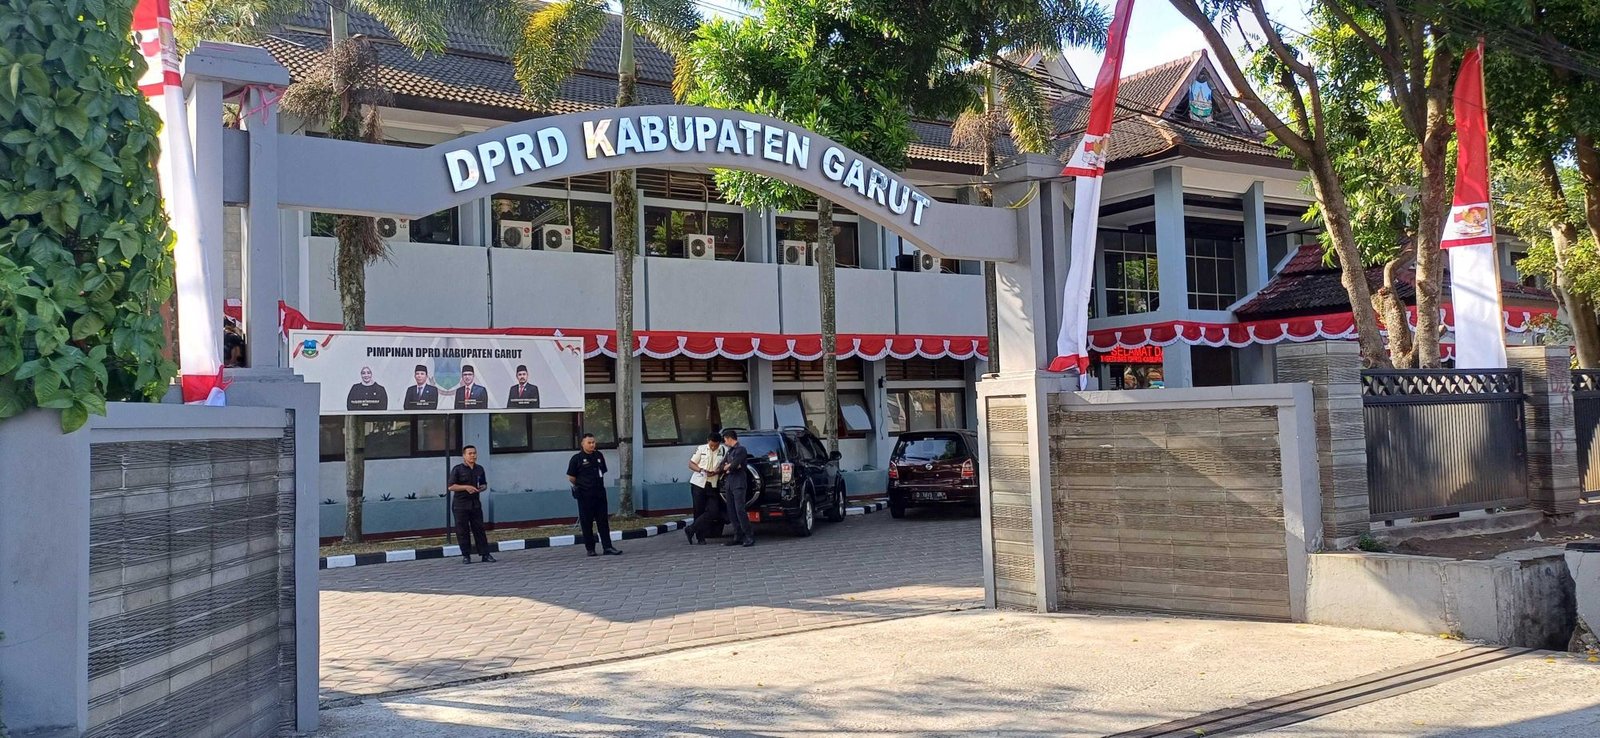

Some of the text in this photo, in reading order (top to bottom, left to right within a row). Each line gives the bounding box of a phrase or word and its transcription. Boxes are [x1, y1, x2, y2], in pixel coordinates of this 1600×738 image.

[445, 115, 930, 226] DPRD KABUPATEN GARUT
[366, 346, 522, 359] PIMPINAN DPRD KABUPATEN GARUT
